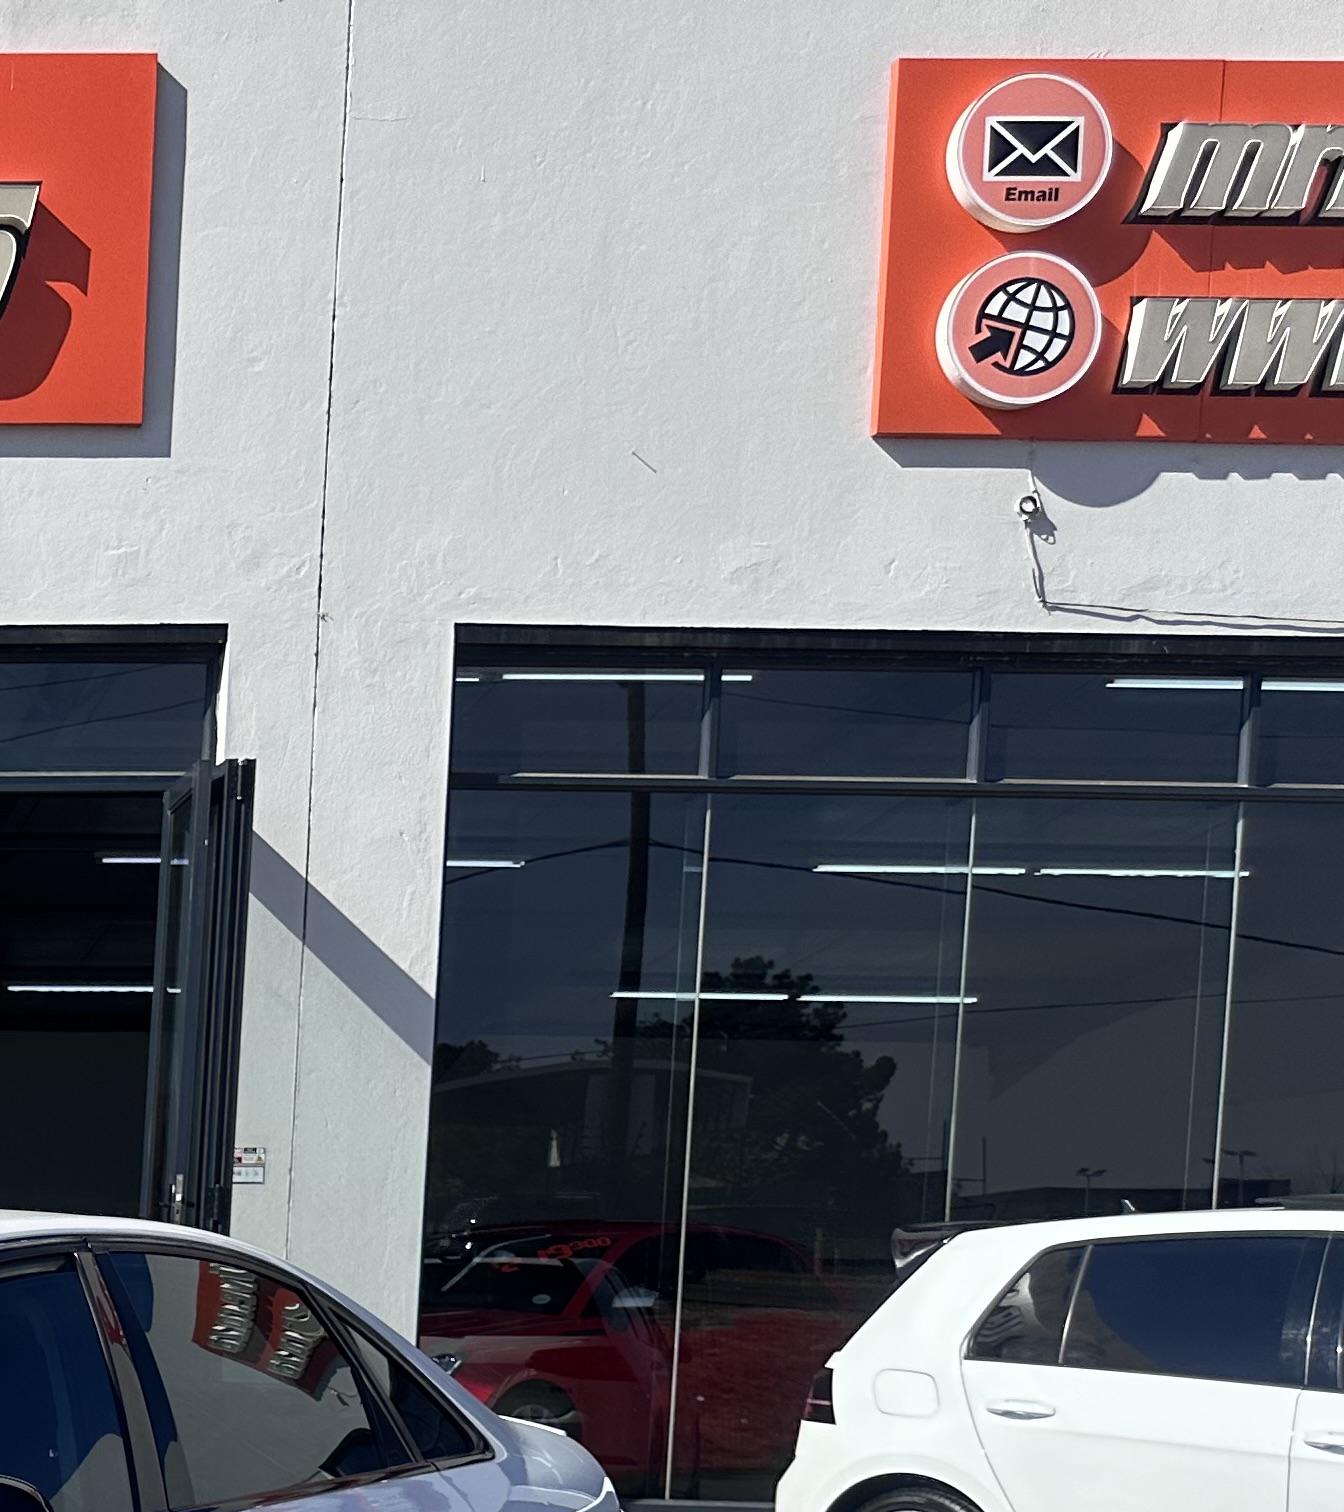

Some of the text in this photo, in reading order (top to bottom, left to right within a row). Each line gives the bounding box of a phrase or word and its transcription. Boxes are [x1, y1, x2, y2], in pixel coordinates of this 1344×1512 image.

[1004, 187, 1060, 202] Email
[1138, 121, 1344, 218] mr
[1120, 298, 1344, 393] ww
